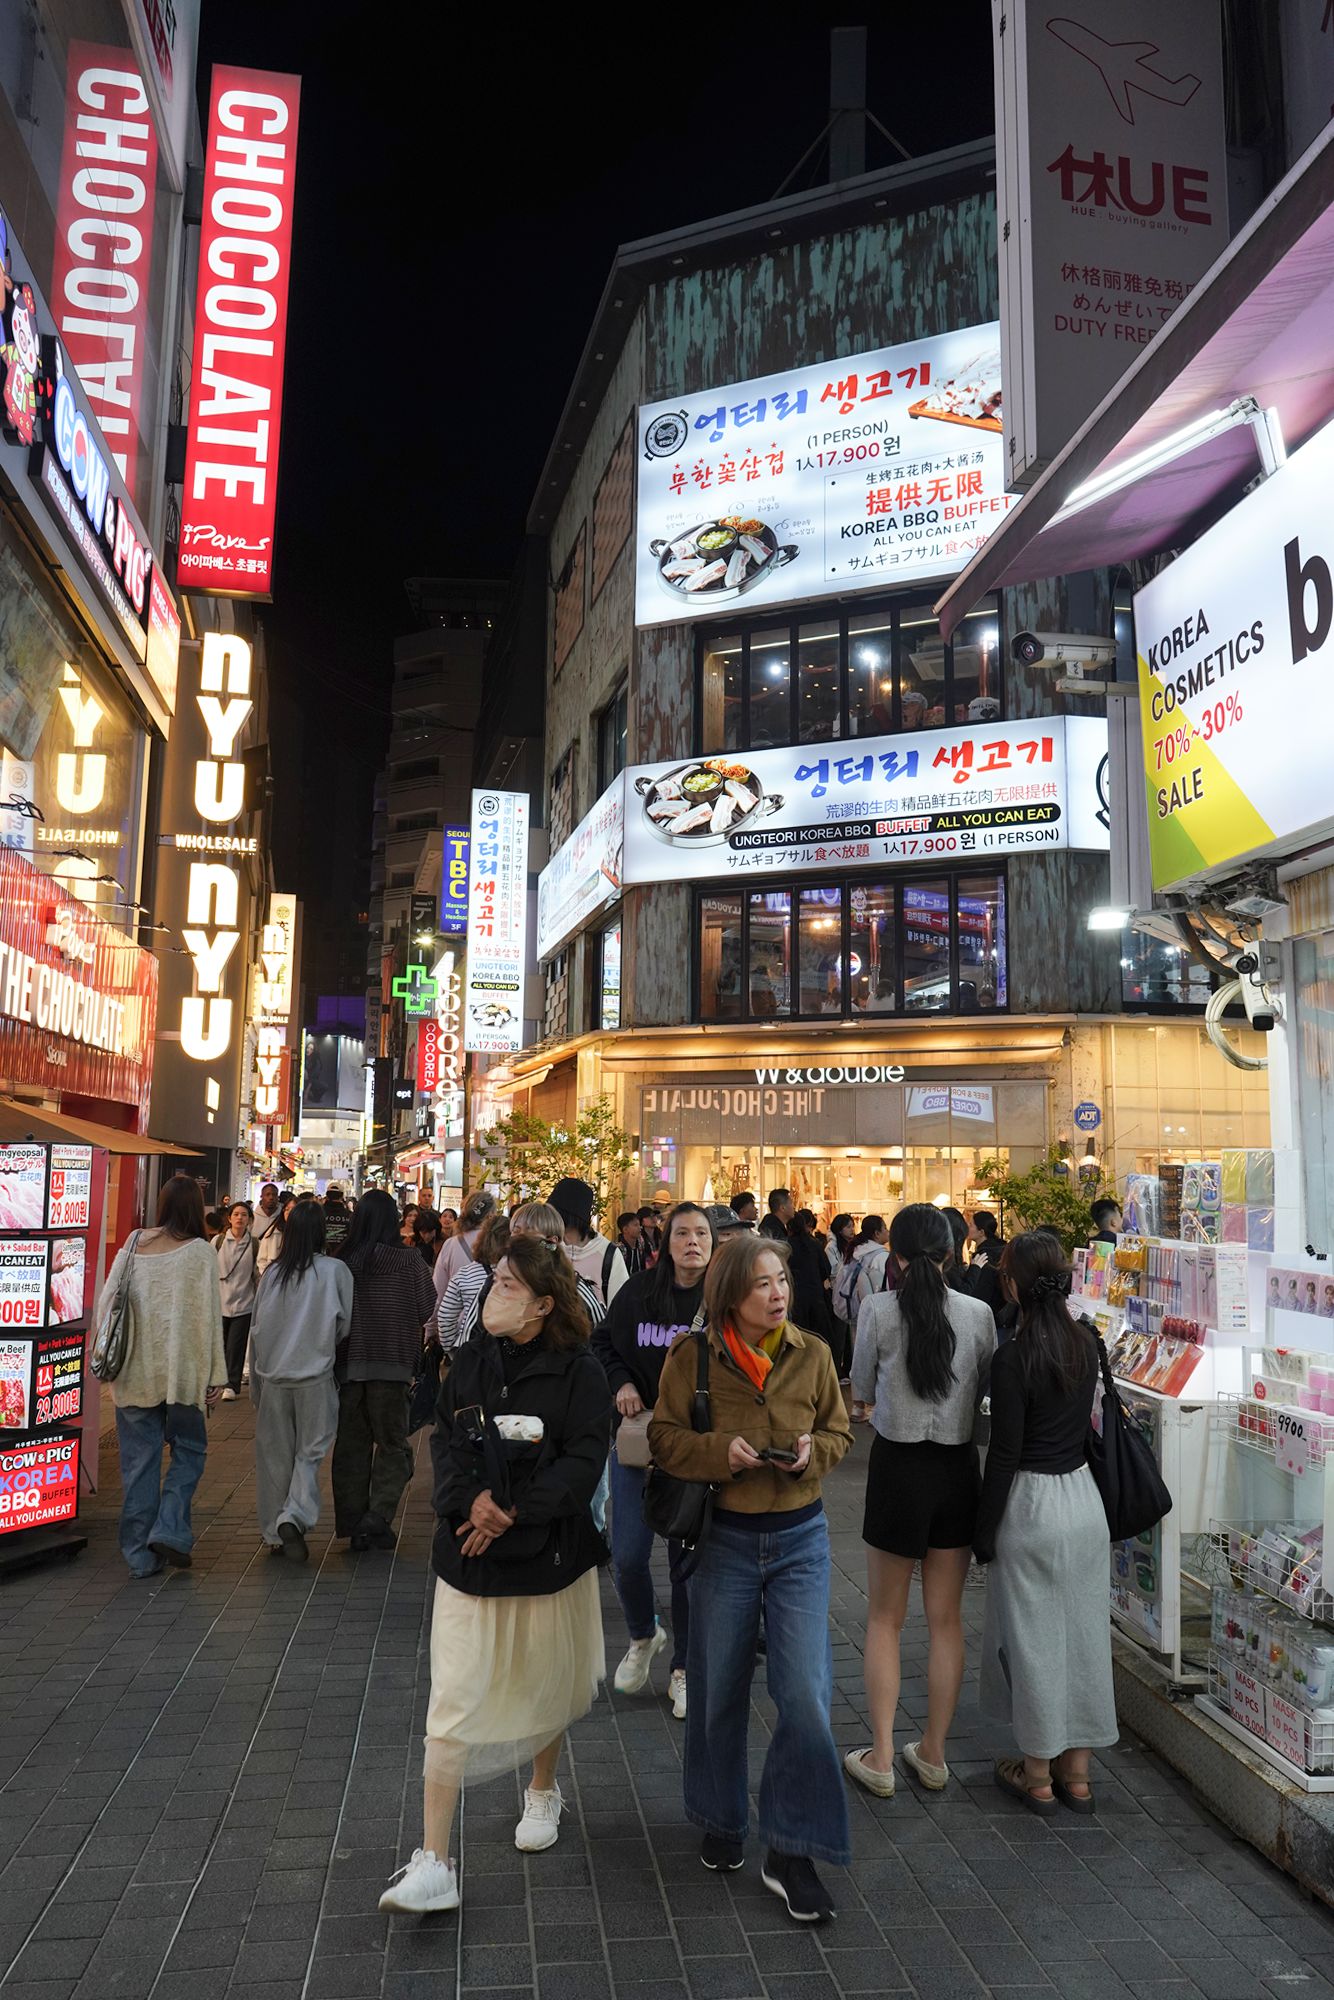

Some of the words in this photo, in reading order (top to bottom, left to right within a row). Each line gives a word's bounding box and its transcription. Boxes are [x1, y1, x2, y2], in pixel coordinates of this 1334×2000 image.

[1071, 206, 1096, 217] HUE
[1109, 212, 1146, 227] buying
[1149, 220, 1189, 234] gallery
[193, 90, 289, 505] CHOCOLATE
[1054, 315, 1108, 337] DUTY
[694, 389, 808, 443] 엉터리
[820, 362, 931, 415] 생고기
[822, 420, 889, 445] PERSON)
[55, 376, 110, 534] COW
[113, 498, 144, 615] PIG
[866, 470, 984, 516] 提供无限
[841, 517, 898, 539] KOREA
[903, 510, 939, 528] BBQ
[944, 496, 1012, 520] BUFFET
[873, 535, 894, 547] ALL
[898, 531, 922, 542] YOU
[926, 526, 951, 538] CAN
[955, 520, 977, 532] EAT
[1148, 609, 1209, 677] KOREA
[1151, 621, 1265, 721] COSMETICS
[1154, 690, 1243, 773] 70%~30%
[794, 751, 918, 798] 엉터리
[932, 737, 1053, 785] 생고기
[1157, 768, 1204, 819] SALE
[826, 799, 898, 819] 荒谬的生肉
[735, 831, 797, 846] UNGTEORI
[800, 828, 842, 841] KOREA
[845, 825, 871, 837] BBQ
[876, 818, 931, 834] BUFFET
[937, 817, 960, 828] ALL
[963, 813, 992, 826] YOU
[995, 810, 1023, 823] CAN
[1027, 808, 1053, 820] EAT
[999, 828, 1059, 844] PERSON)
[175, 834, 257, 852] WHOLESALE
[477, 820, 498, 875] 엉터리
[449, 840, 468, 899] TBC
[474, 881, 496, 937] 생고기
[472, 972, 500, 980] KOREA
[502, 973, 520, 982] BBQ
[476, 962, 518, 971] UNGTEORI
[482, 990, 509, 999] BUFFET
[34, 963, 124, 1056] CHOCOLATE
[423, 1023, 436, 1089] COCOREA
[1079, 1110, 1097, 1121] ADT
[50, 1201, 87, 1225] 29,800원
[13, 1243, 31, 1252] Salad
[33, 1243, 45, 1251] Bar
[0, 1300, 39, 1323] 00원
[8, 1345, 26, 1353] Beef
[36, 1388, 80, 1424] 29,800원
[2, 1452, 37, 1471] COW
[38, 1454, 45, 1462] &
[46, 1446, 72, 1463] PIG
[0, 1464, 73, 1494] KOREA
[0, 1488, 39, 1513] BBQ
[42, 1487, 75, 1501] BUFFET
[0, 1516, 15, 1528] ALL
[16, 1512, 35, 1524] YOU
[36, 1507, 54, 1520] CAN
[56, 1504, 72, 1516] EAT
[1235, 1671, 1256, 1692] MASK
[1234, 1689, 1244, 1702] 50
[1245, 1696, 1258, 1713] PCS
[1272, 1697, 1296, 1722] MASK
[1245, 1716, 1265, 1737] 9,000
[1271, 1715, 1280, 1729] 10
[1284, 1723, 1298, 1742] PCS
[1284, 1742, 1304, 1766] 2,000
